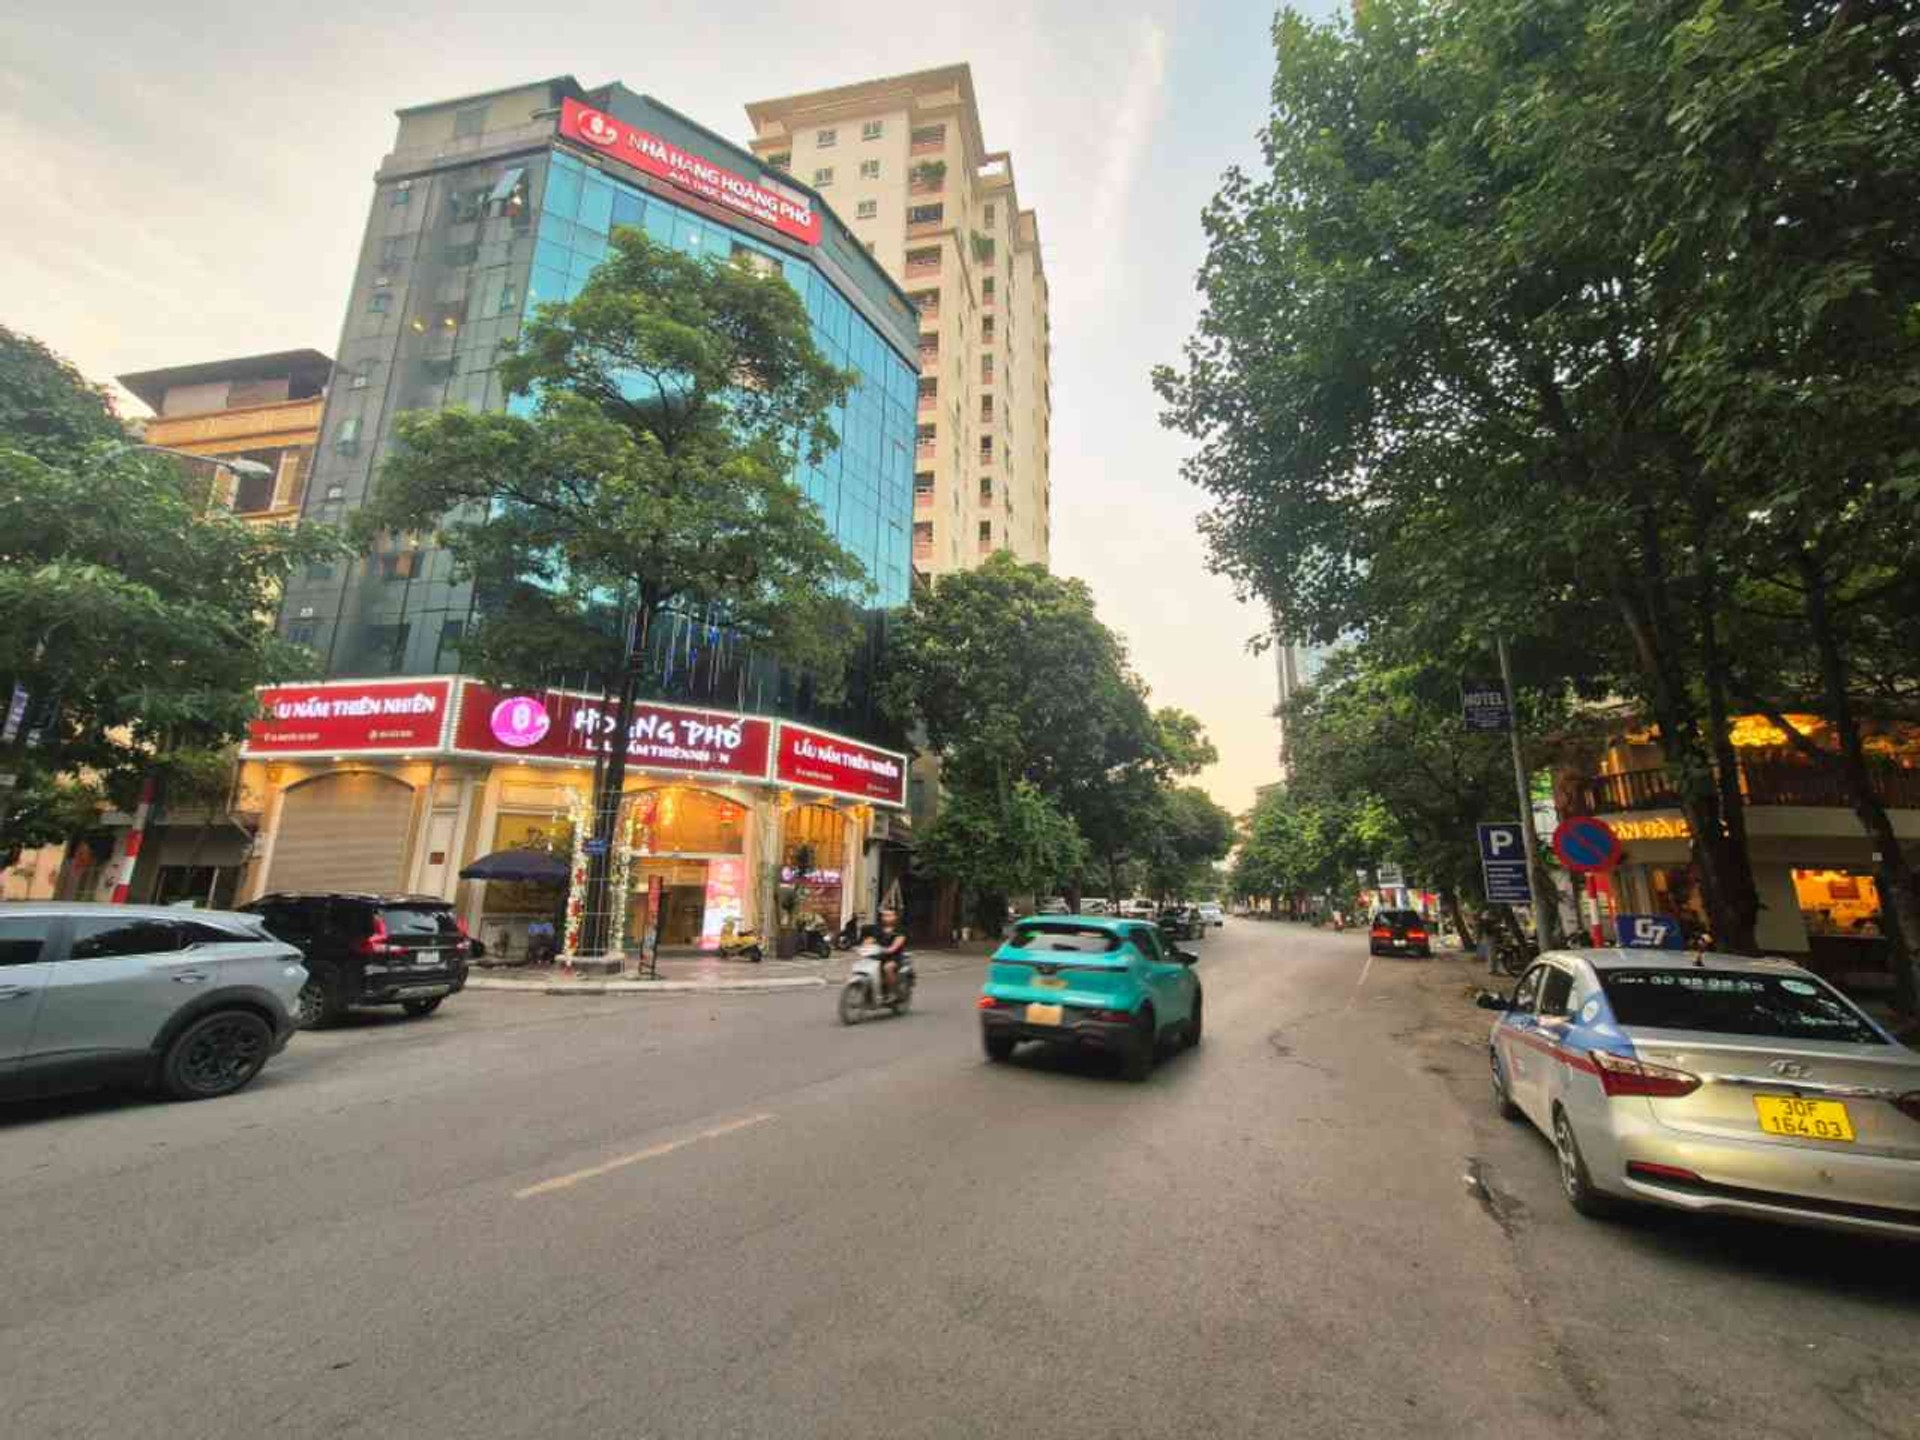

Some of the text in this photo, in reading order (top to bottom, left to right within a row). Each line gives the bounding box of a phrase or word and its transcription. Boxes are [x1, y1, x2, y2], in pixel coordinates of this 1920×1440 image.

[1490, 830, 1513, 855] P
[1778, 1099, 1818, 1117] 30F
[1771, 1116, 1843, 1138] 164.03
